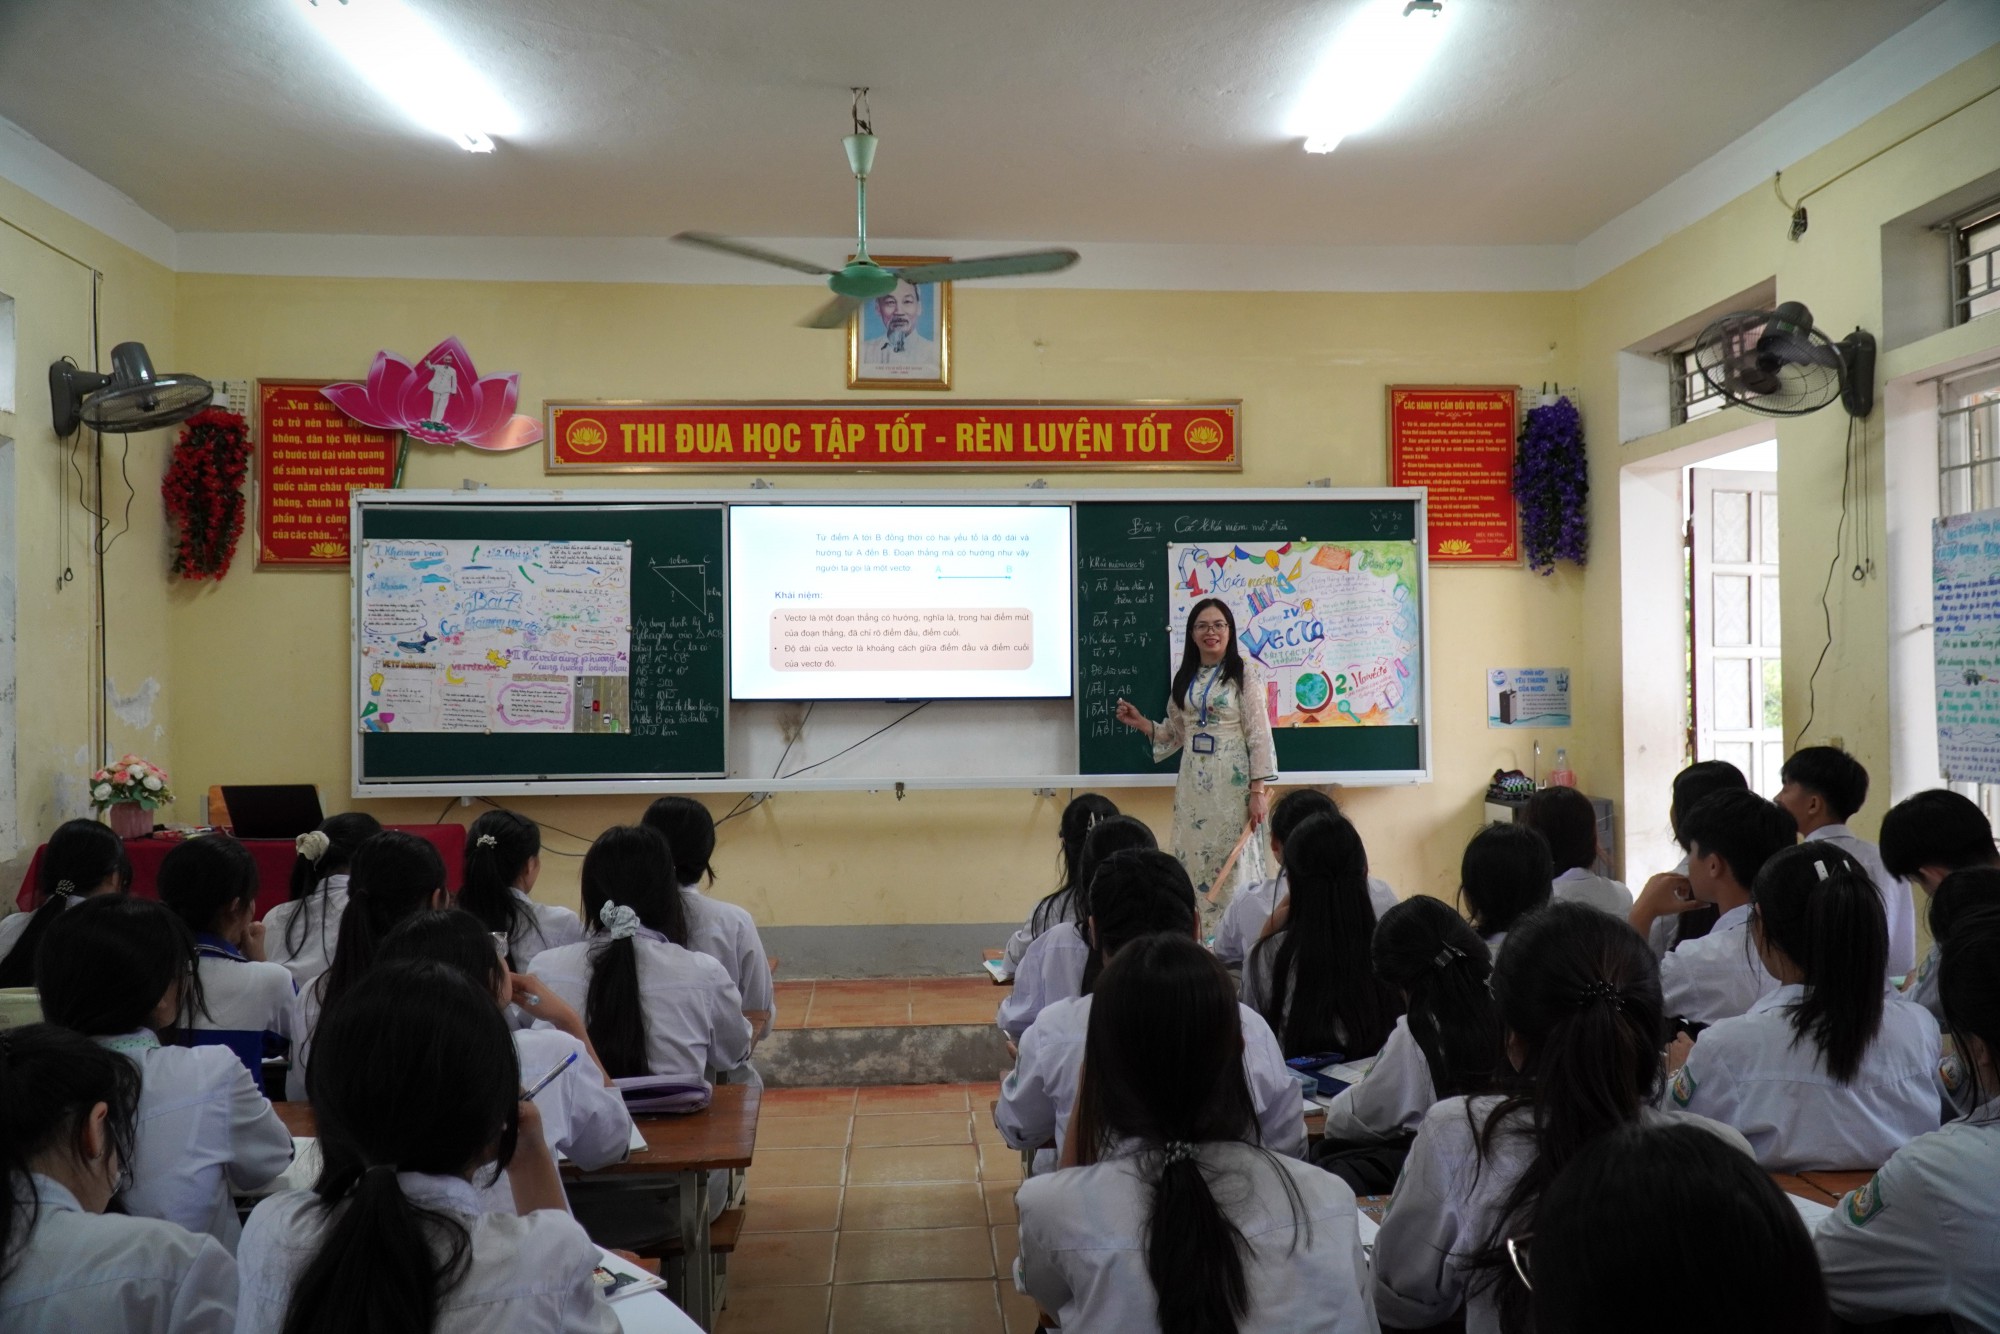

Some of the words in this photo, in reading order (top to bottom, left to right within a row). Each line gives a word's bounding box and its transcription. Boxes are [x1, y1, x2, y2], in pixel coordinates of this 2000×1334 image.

[313, 401, 336, 411] sông
[272, 417, 284, 428] có
[288, 417, 301, 428] trở
[305, 417, 322, 428] nên
[272, 433, 303, 445] không,
[306, 433, 323, 445] dân
[326, 433, 341, 445] tộc
[343, 433, 361, 445] Việt
[364, 433, 385, 445] Nam
[620, 423, 665, 453] THI
[675, 423, 734, 453] ĐUA
[743, 423, 801, 459] HỌC
[811, 417, 866, 460] TẬP
[875, 412, 926, 453] TỐT
[956, 417, 1013, 452] RÈN
[1023, 417, 1113, 459] LUYỆN
[1122, 413, 1172, 452] TỐT
[273, 450, 284, 460] có
[285, 450, 308, 460] bước
[308, 450, 320, 460] tới
[322, 450, 336, 460] đài
[337, 450, 356, 460] vinh
[358, 450, 385, 460] quang
[273, 465, 284, 476] để
[286, 465, 307, 476] sánh
[309, 465, 322, 476] vai
[324, 465, 338, 476] với
[340, 465, 356, 476] các
[358, 465, 385, 476] cường
[273, 480, 295, 491] quốc
[298, 482, 317, 491] năm
[320, 482, 342, 491] châu
[273, 498, 303, 508] không,
[307, 498, 331, 508] chính
[335, 498, 344, 508] là
[273, 512, 295, 524] phần
[298, 512, 313, 524] lớn
[316, 512, 322, 524] ở
[326, 512, 347, 524] công
[273, 529, 289, 540] của
[290, 529, 307, 540] các
[774, 591, 796, 600] Khái
[797, 591, 823, 601] niệm:
[784, 614, 808, 622] Vectơ
[809, 614, 817, 622] là
[818, 614, 834, 623] một
[835, 614, 855, 623] đoạn
[856, 612, 879, 624] thẳng
[892, 613, 922, 623] hướng,
[922, 613, 945, 623] nghĩa
[946, 613, 956, 622] là,
[958, 614, 978, 623] trong
[980, 613, 992, 622] hai
[993, 611, 1013, 622] điểm
[1014, 613, 1029, 622] mút
[784, 628, 799, 638] của
[800, 629, 820, 639] đoạn
[821, 627, 846, 639] thẳng,
[847, 629, 858, 637] đã
[859, 628, 872, 637] chỉ
[872, 629, 882, 637] rõ
[882, 627, 902, 637] điểm
[903, 627, 921, 637] đầu,
[922, 627, 942, 637] điểm
[942, 627, 961, 637] cuối.
[784, 644, 797, 654] Độ
[798, 644, 811, 653] dài
[814, 644, 829, 653] của
[831, 645, 854, 653] vectơ
[856, 644, 864, 652] là
[866, 643, 895, 654] khoảng
[897, 644, 917, 652] cách
[919, 644, 937, 654] giữa
[939, 642, 959, 652] điểm
[961, 642, 977, 652] đầu
[979, 644, 989, 652] và
[991, 642, 1011, 652] điểm
[1013, 643, 1030, 652] cuối
[784, 659, 799, 668] của
[800, 660, 823, 668] vectơ
[824, 659, 837, 668] đó.
